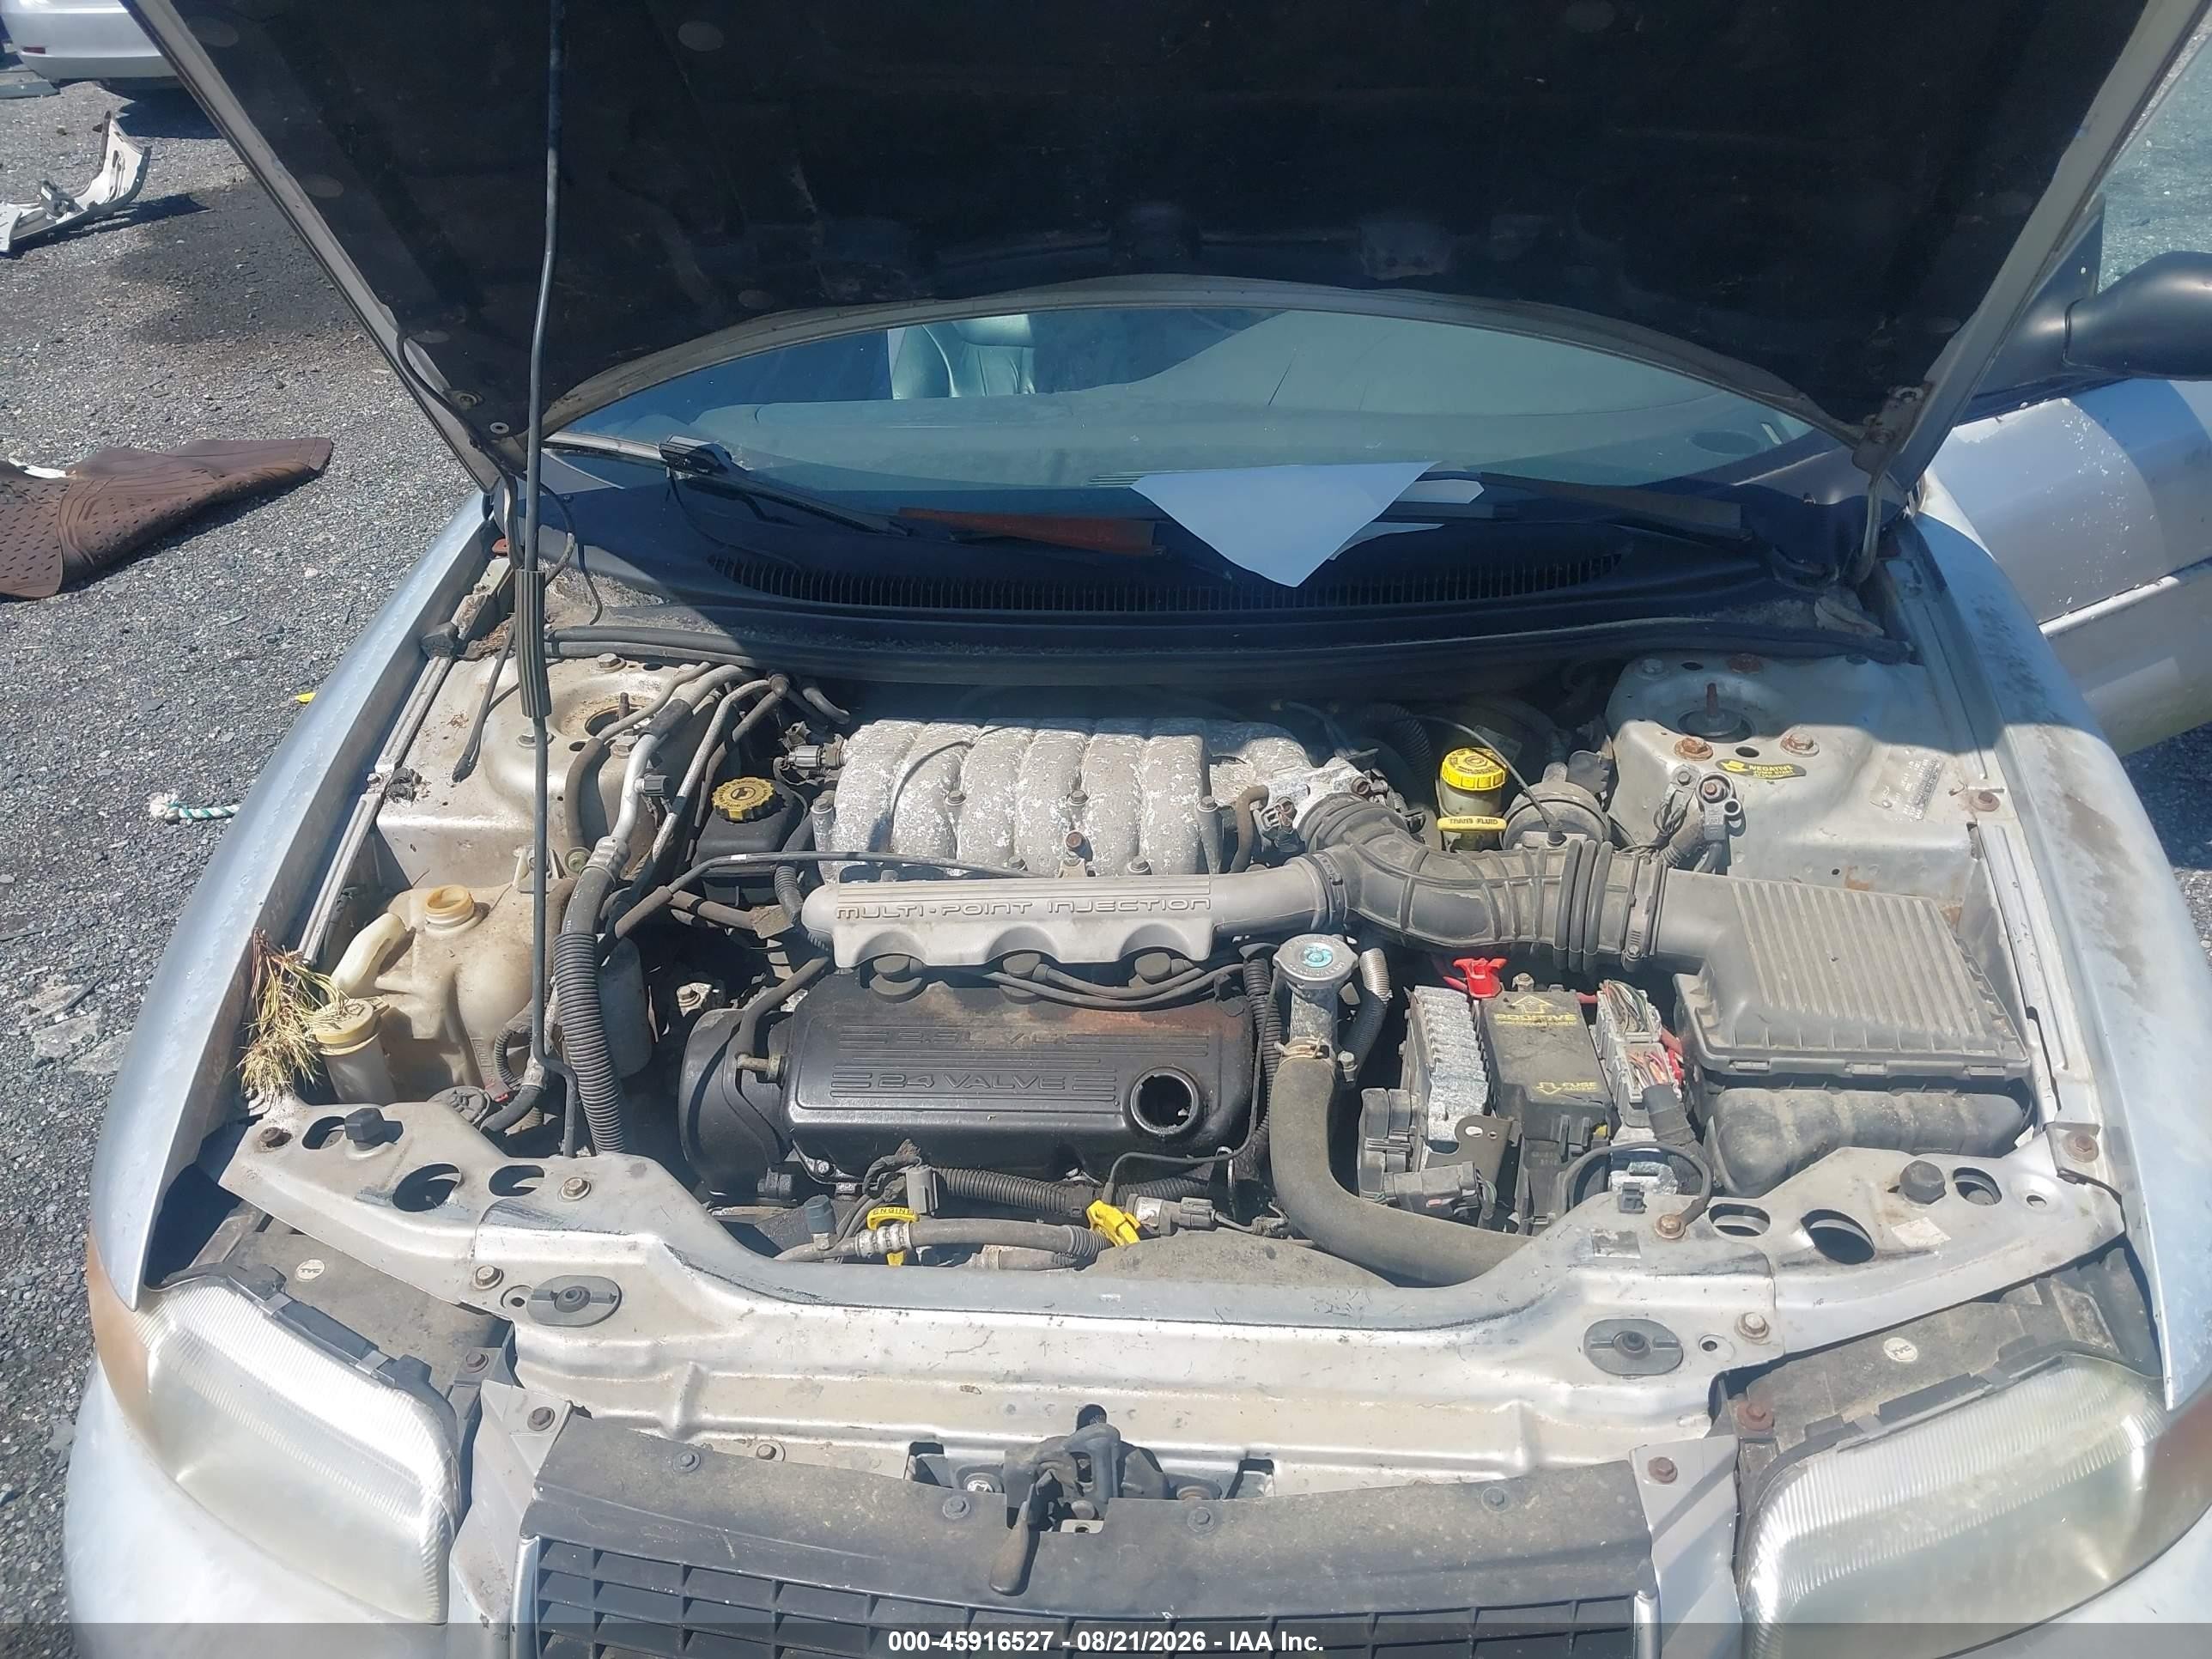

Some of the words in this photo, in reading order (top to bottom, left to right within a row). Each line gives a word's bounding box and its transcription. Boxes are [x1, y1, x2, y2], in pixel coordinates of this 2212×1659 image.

[1047, 898, 1212, 914] INJECTION
[1494, 1012, 1577, 1023] POSITIVE
[878, 1073, 934, 1088] 24
[943, 1073, 1066, 1090] VALVE
[872, 1207, 914, 1216] ENGINE
